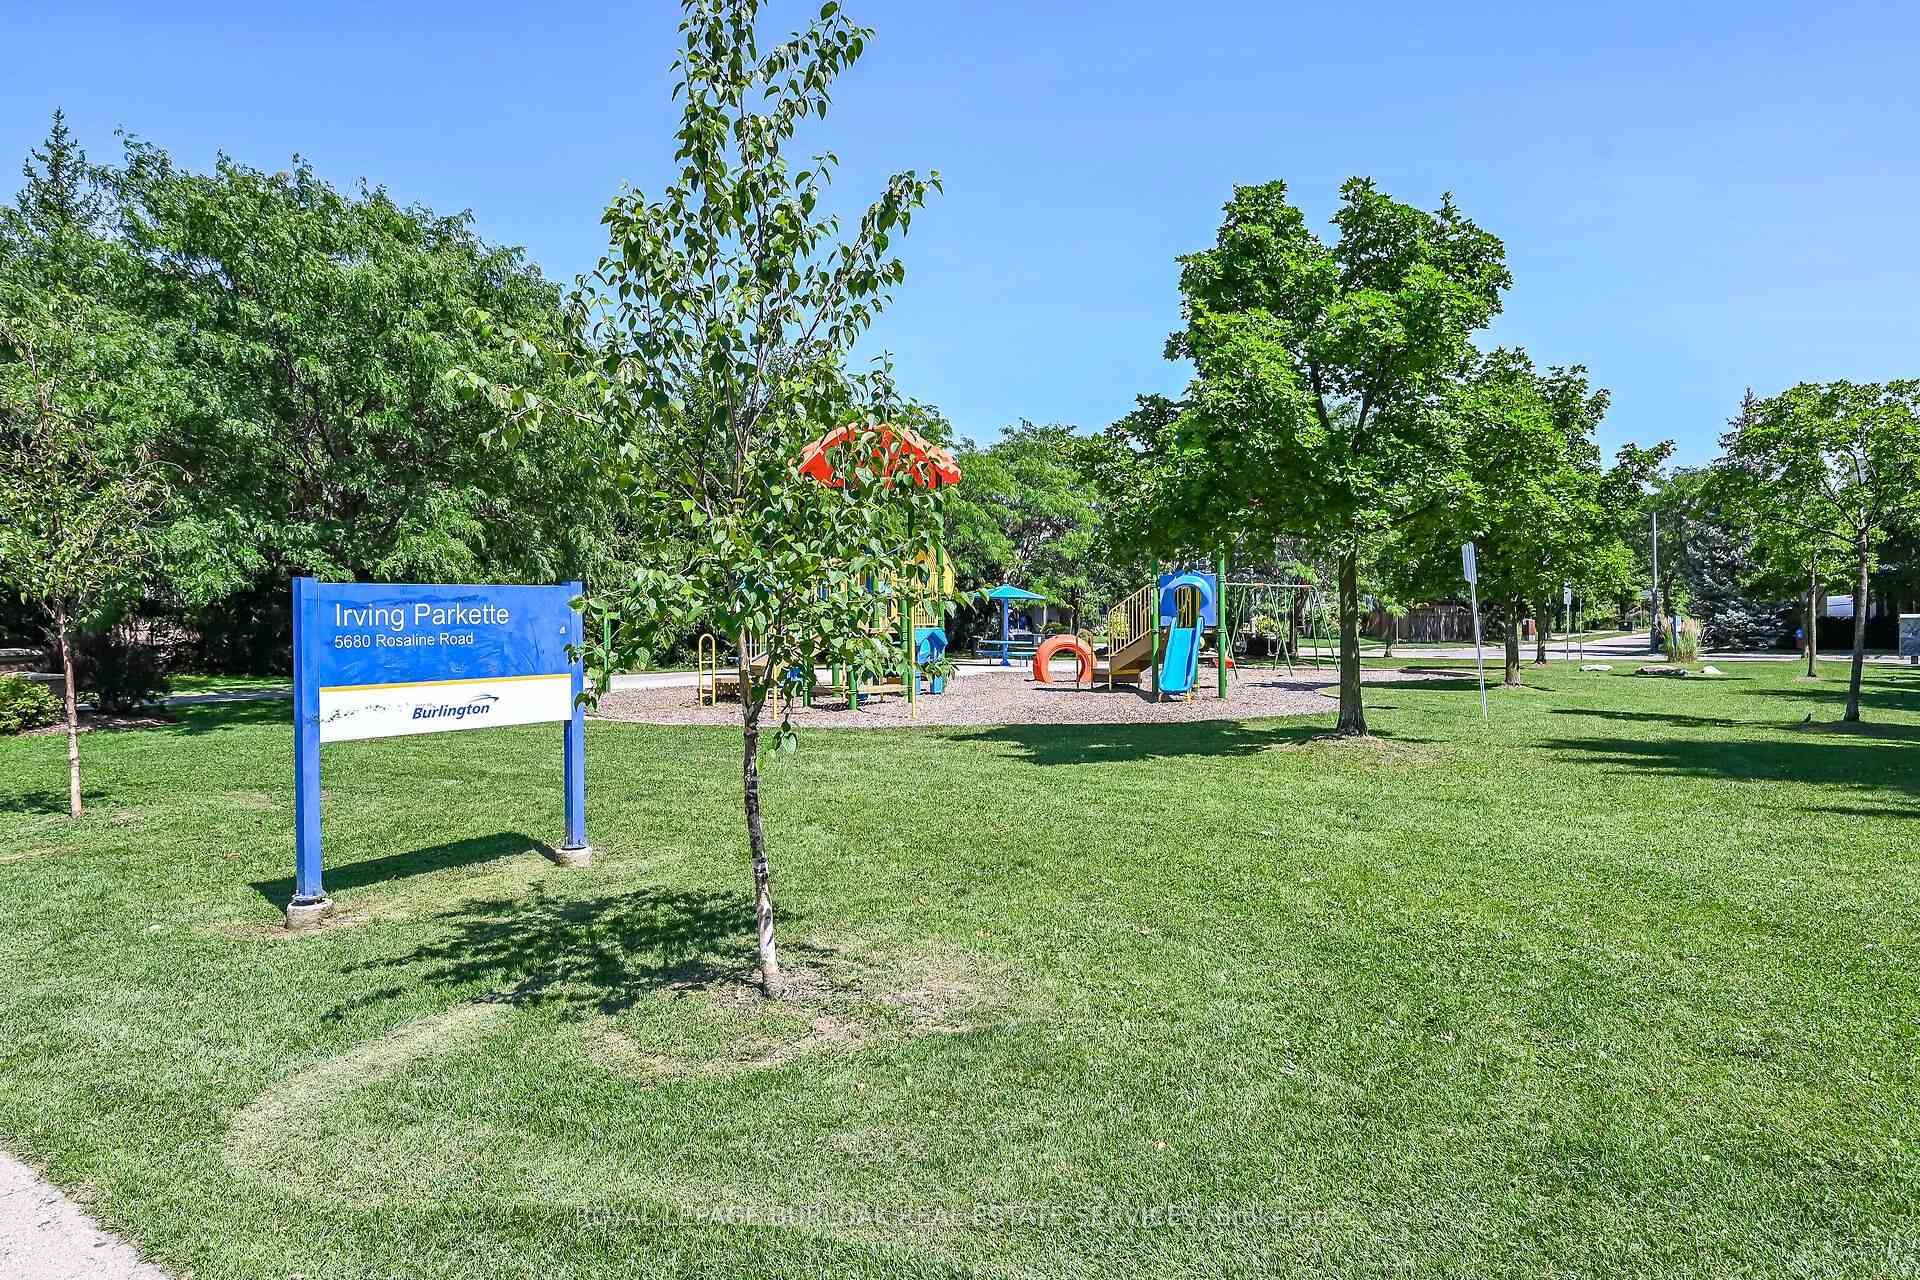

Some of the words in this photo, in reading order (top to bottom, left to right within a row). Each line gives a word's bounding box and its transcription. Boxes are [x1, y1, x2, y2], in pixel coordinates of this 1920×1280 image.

[335, 603, 405, 631] Irving
[414, 602, 509, 625] Parkette
[335, 634, 371, 648] 5680
[376, 632, 435, 647] Rosaline
[439, 631, 474, 646] Road
[412, 703, 490, 720] Burlington
